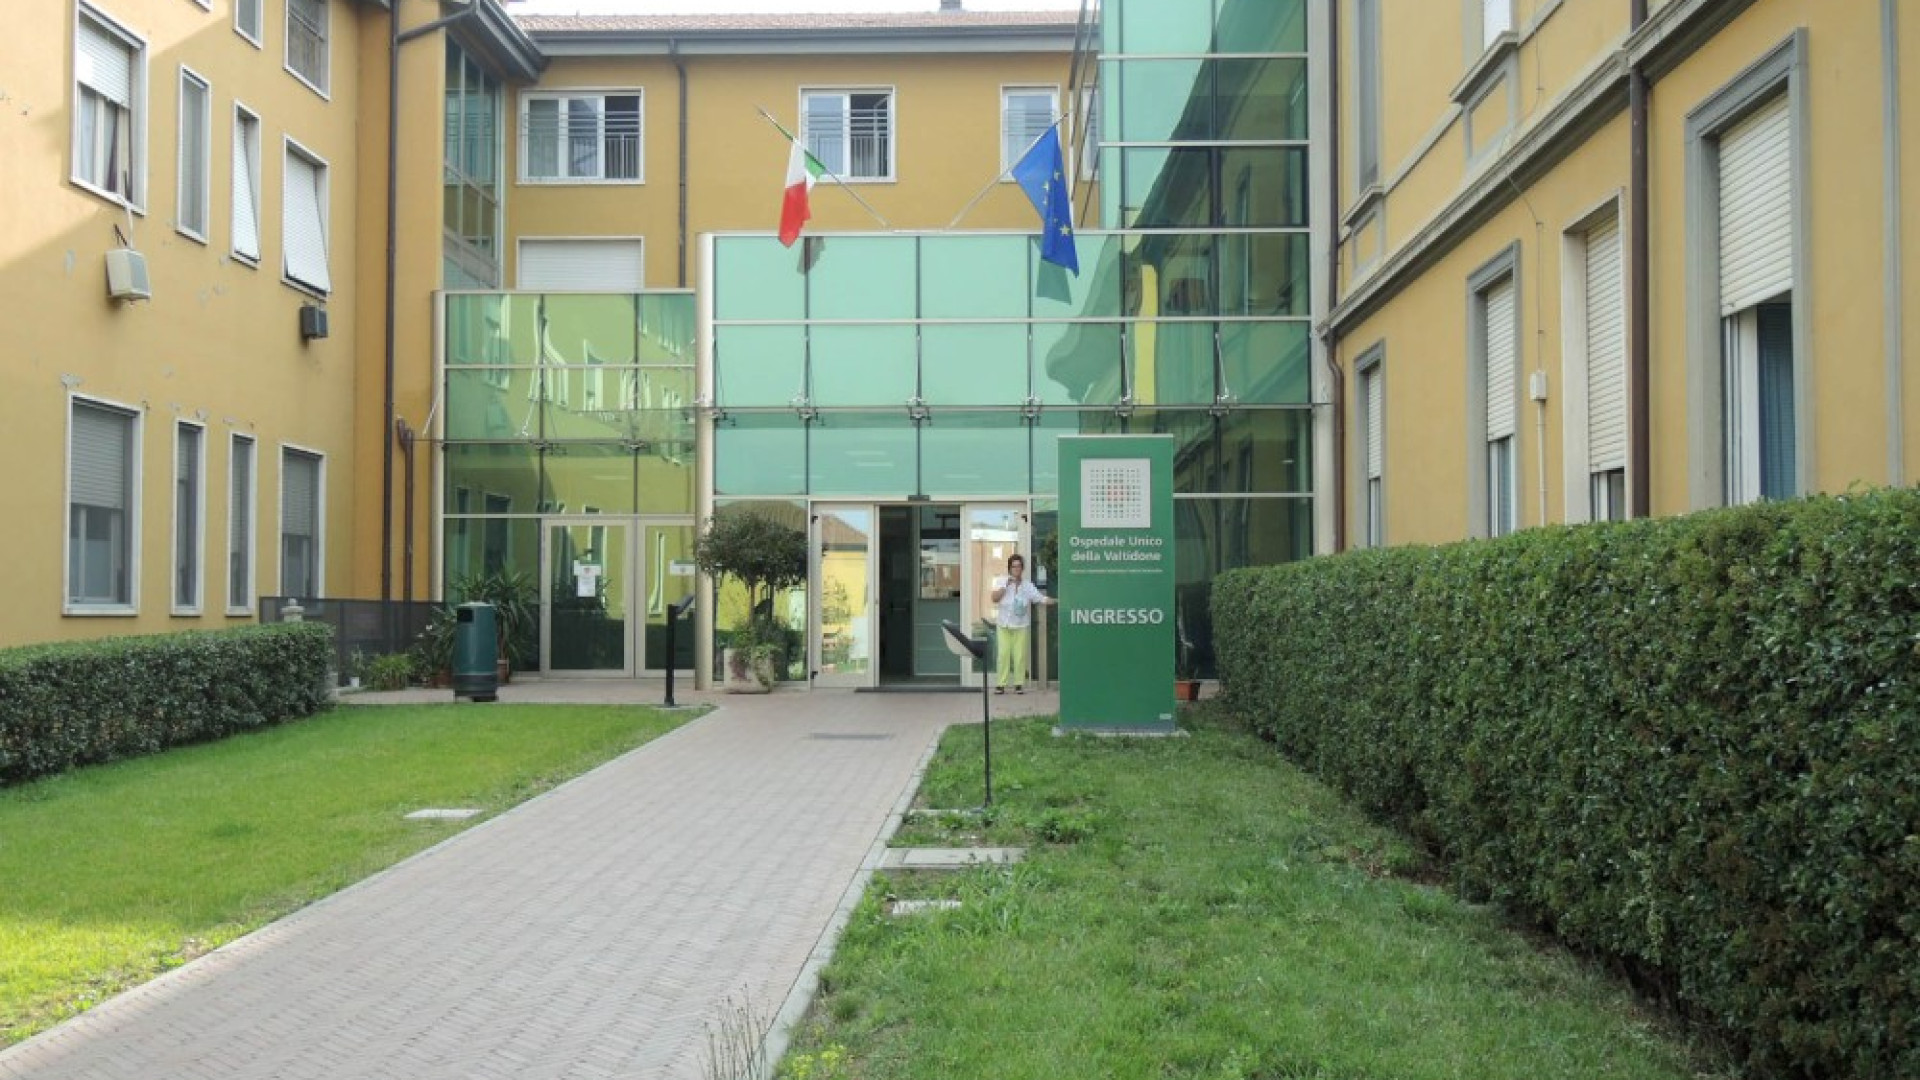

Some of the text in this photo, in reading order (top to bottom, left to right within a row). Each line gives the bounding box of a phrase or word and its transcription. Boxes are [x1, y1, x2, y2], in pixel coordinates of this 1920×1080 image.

[1070, 536, 1162, 549] Ospedale Unico
[1071, 550, 1161, 561] della Valtidone
[1070, 608, 1164, 624] INGRESSO
